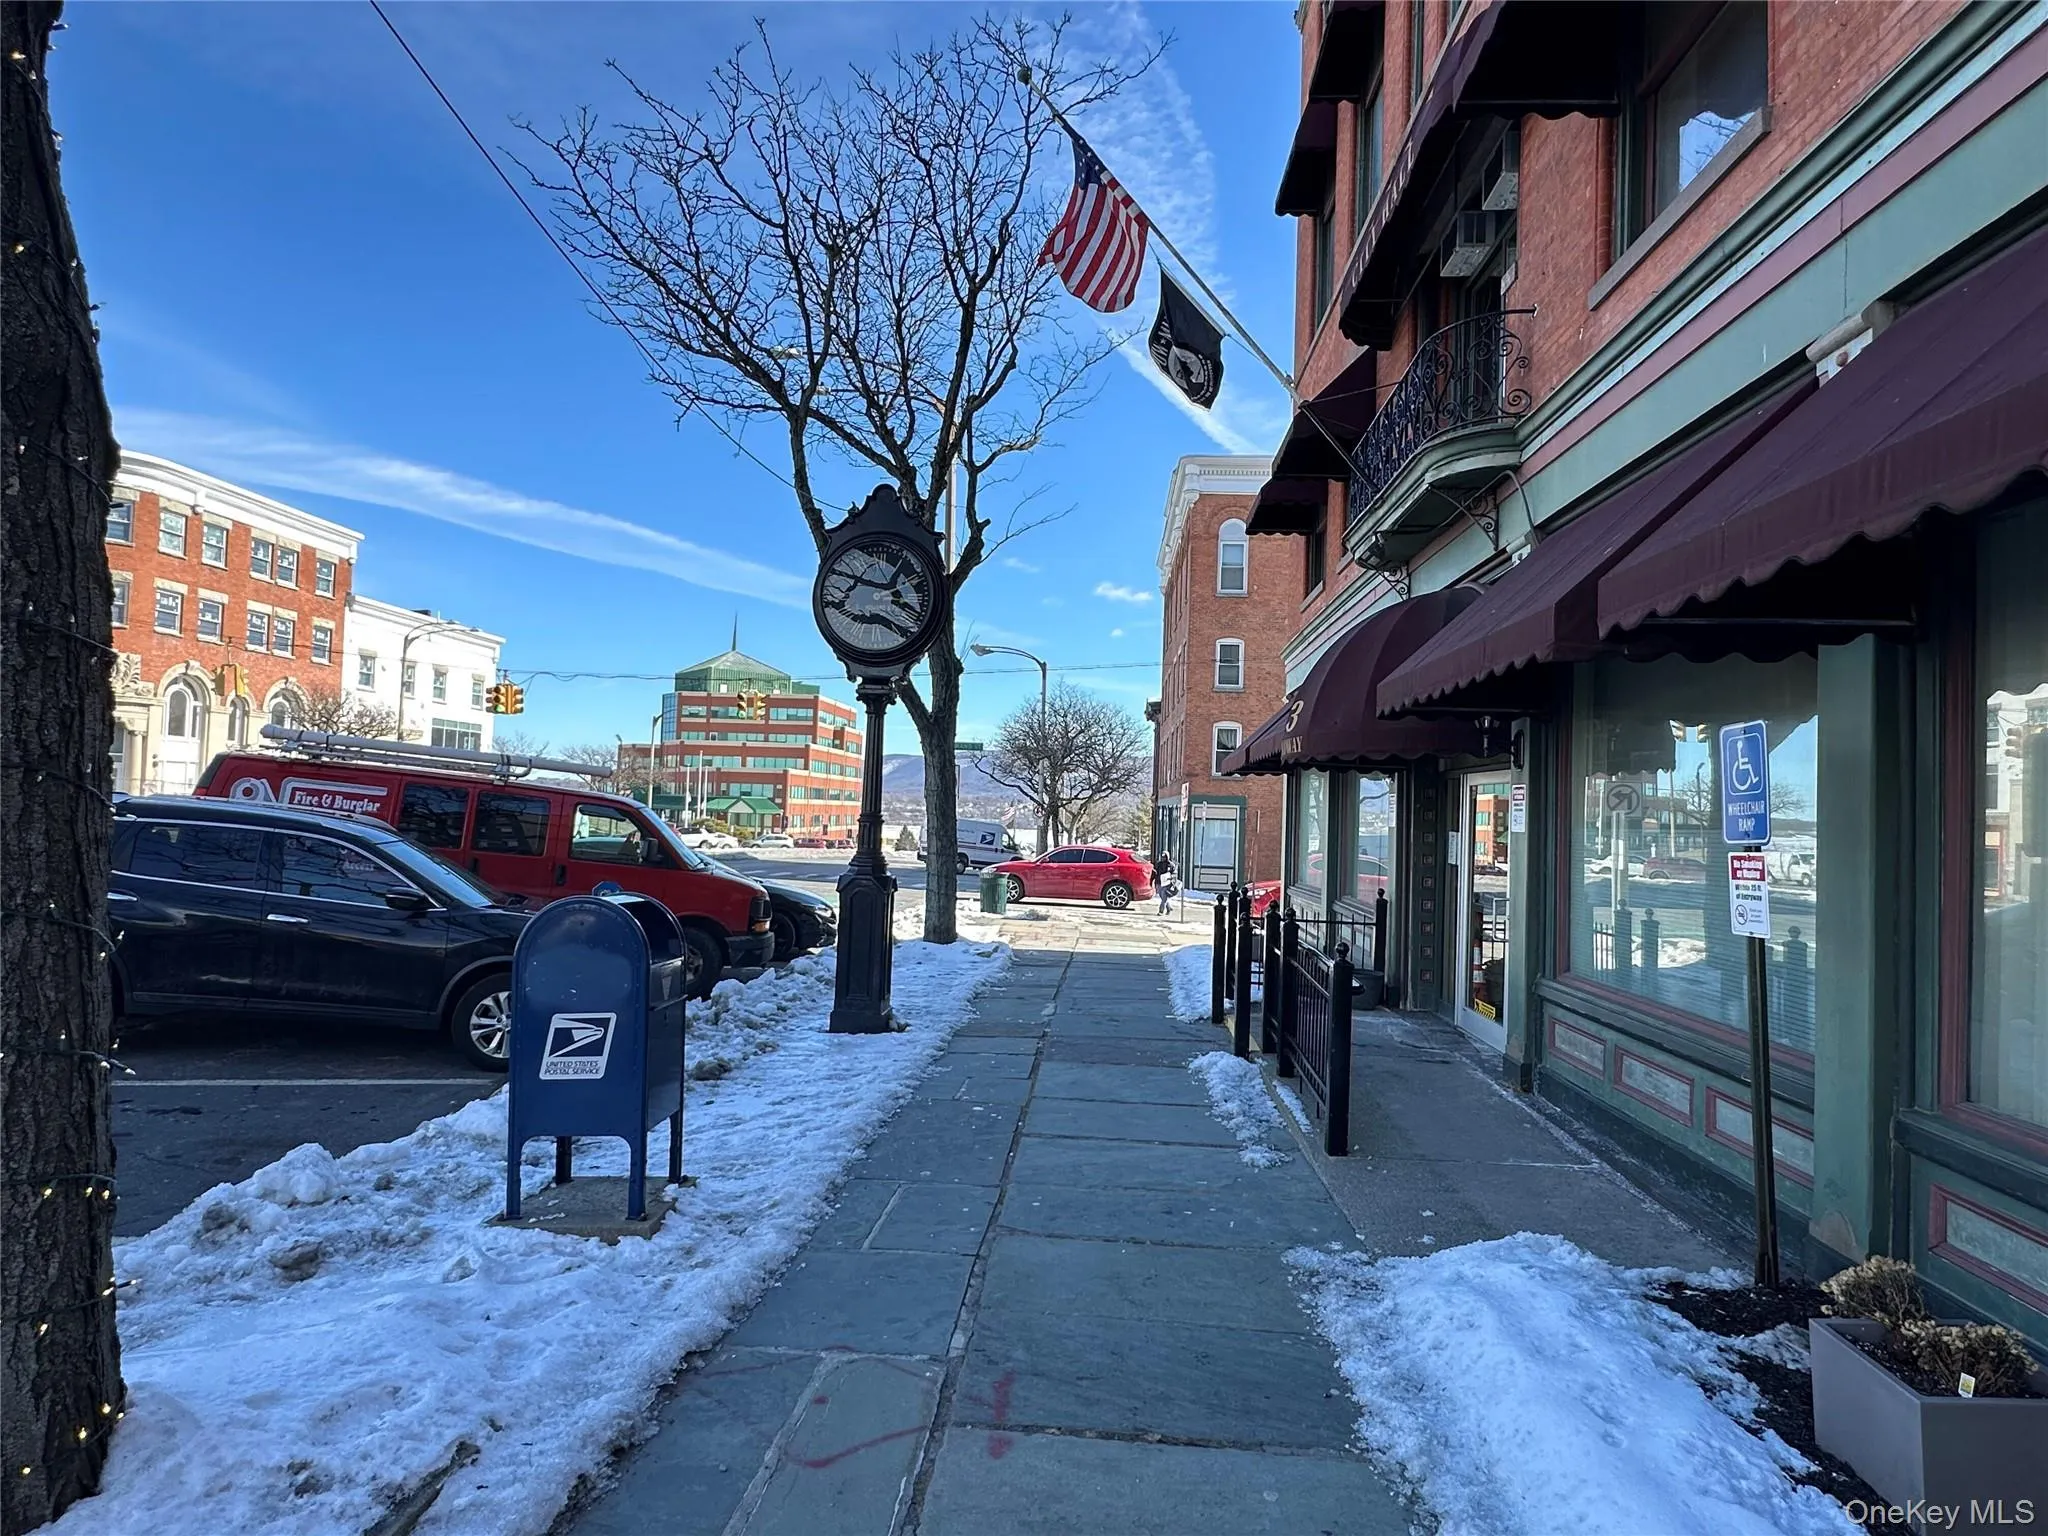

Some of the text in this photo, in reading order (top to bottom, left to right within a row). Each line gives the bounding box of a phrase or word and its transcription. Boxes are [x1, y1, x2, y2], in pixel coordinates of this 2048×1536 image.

[293, 790, 319, 806] Fire
[321, 793, 333, 808] &
[333, 795, 381, 814] Burglar
[1727, 800, 1766, 816] WHEELCHAIR
[1738, 817, 1756, 832] RAMP
[544, 1067, 601, 1075] POSTAL SERVICE
[546, 1060, 600, 1068] UNITED STATES
